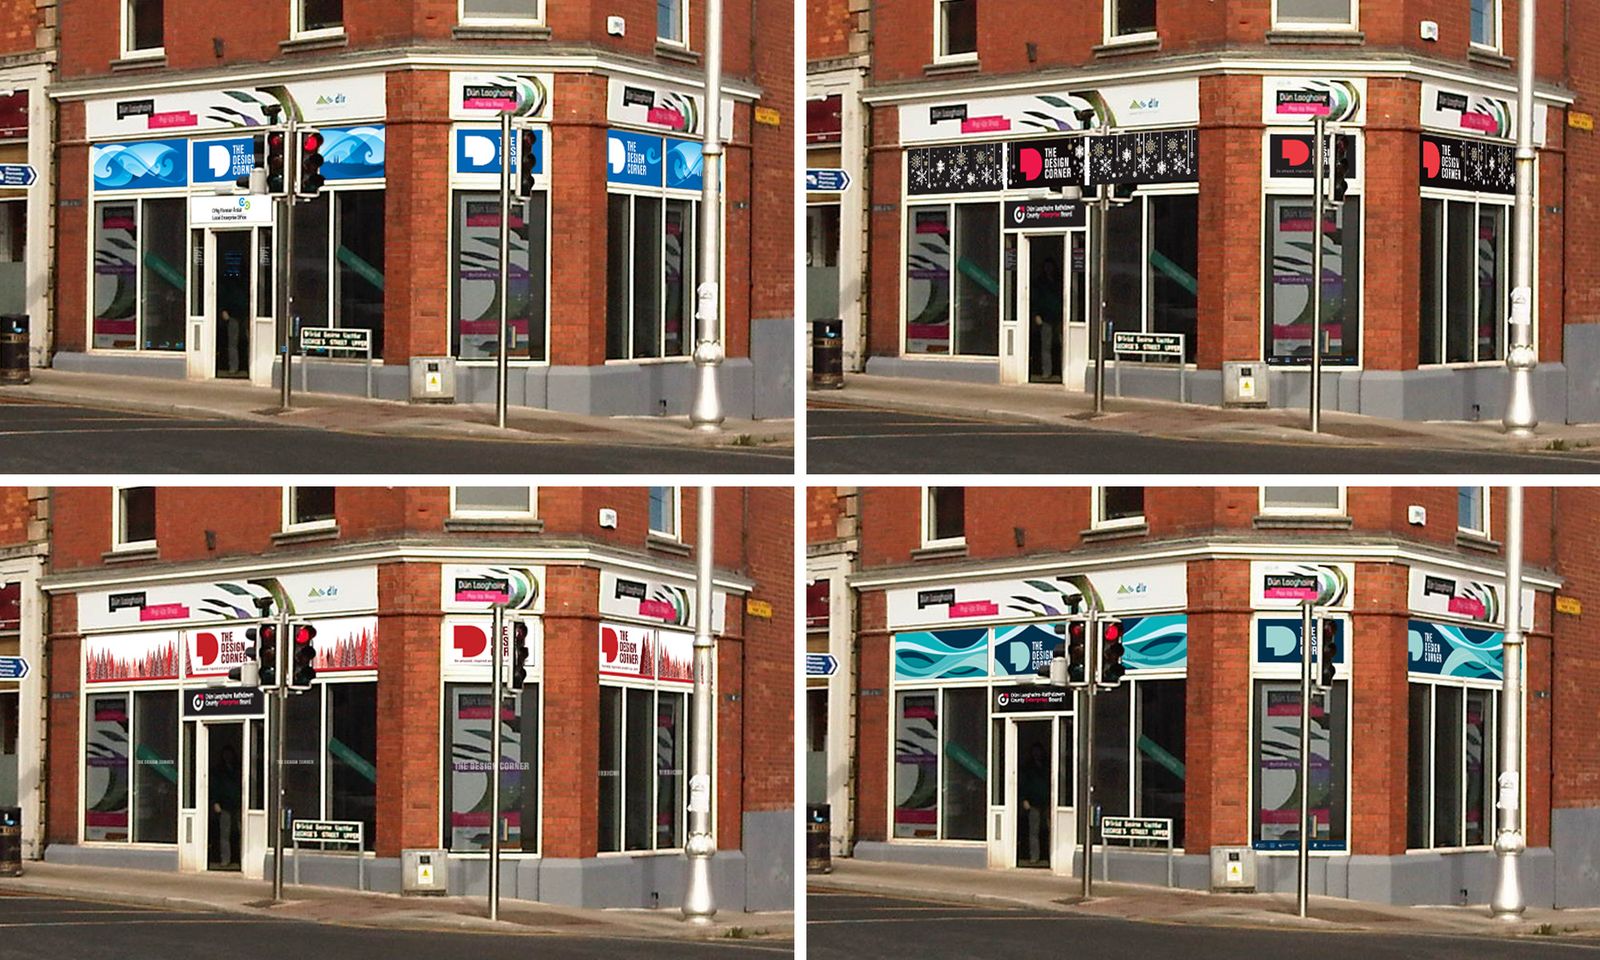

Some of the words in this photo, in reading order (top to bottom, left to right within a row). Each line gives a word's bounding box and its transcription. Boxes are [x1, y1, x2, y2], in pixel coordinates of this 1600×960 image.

[232, 144, 244, 154] THE
[1044, 147, 1057, 157] THE
[1442, 144, 1450, 156] THE
[1044, 157, 1070, 168] DESIGN
[1442, 156, 1460, 168] DESIGN
[1044, 168, 1072, 179] CORNER
[1442, 168, 1461, 180] CORNER
[221, 632, 233, 642] THE
[221, 642, 246, 653] DESIGN
[1032, 640, 1043, 650] THE
[455, 762, 468, 770] THE
[500, 762, 530, 770] CORNER
